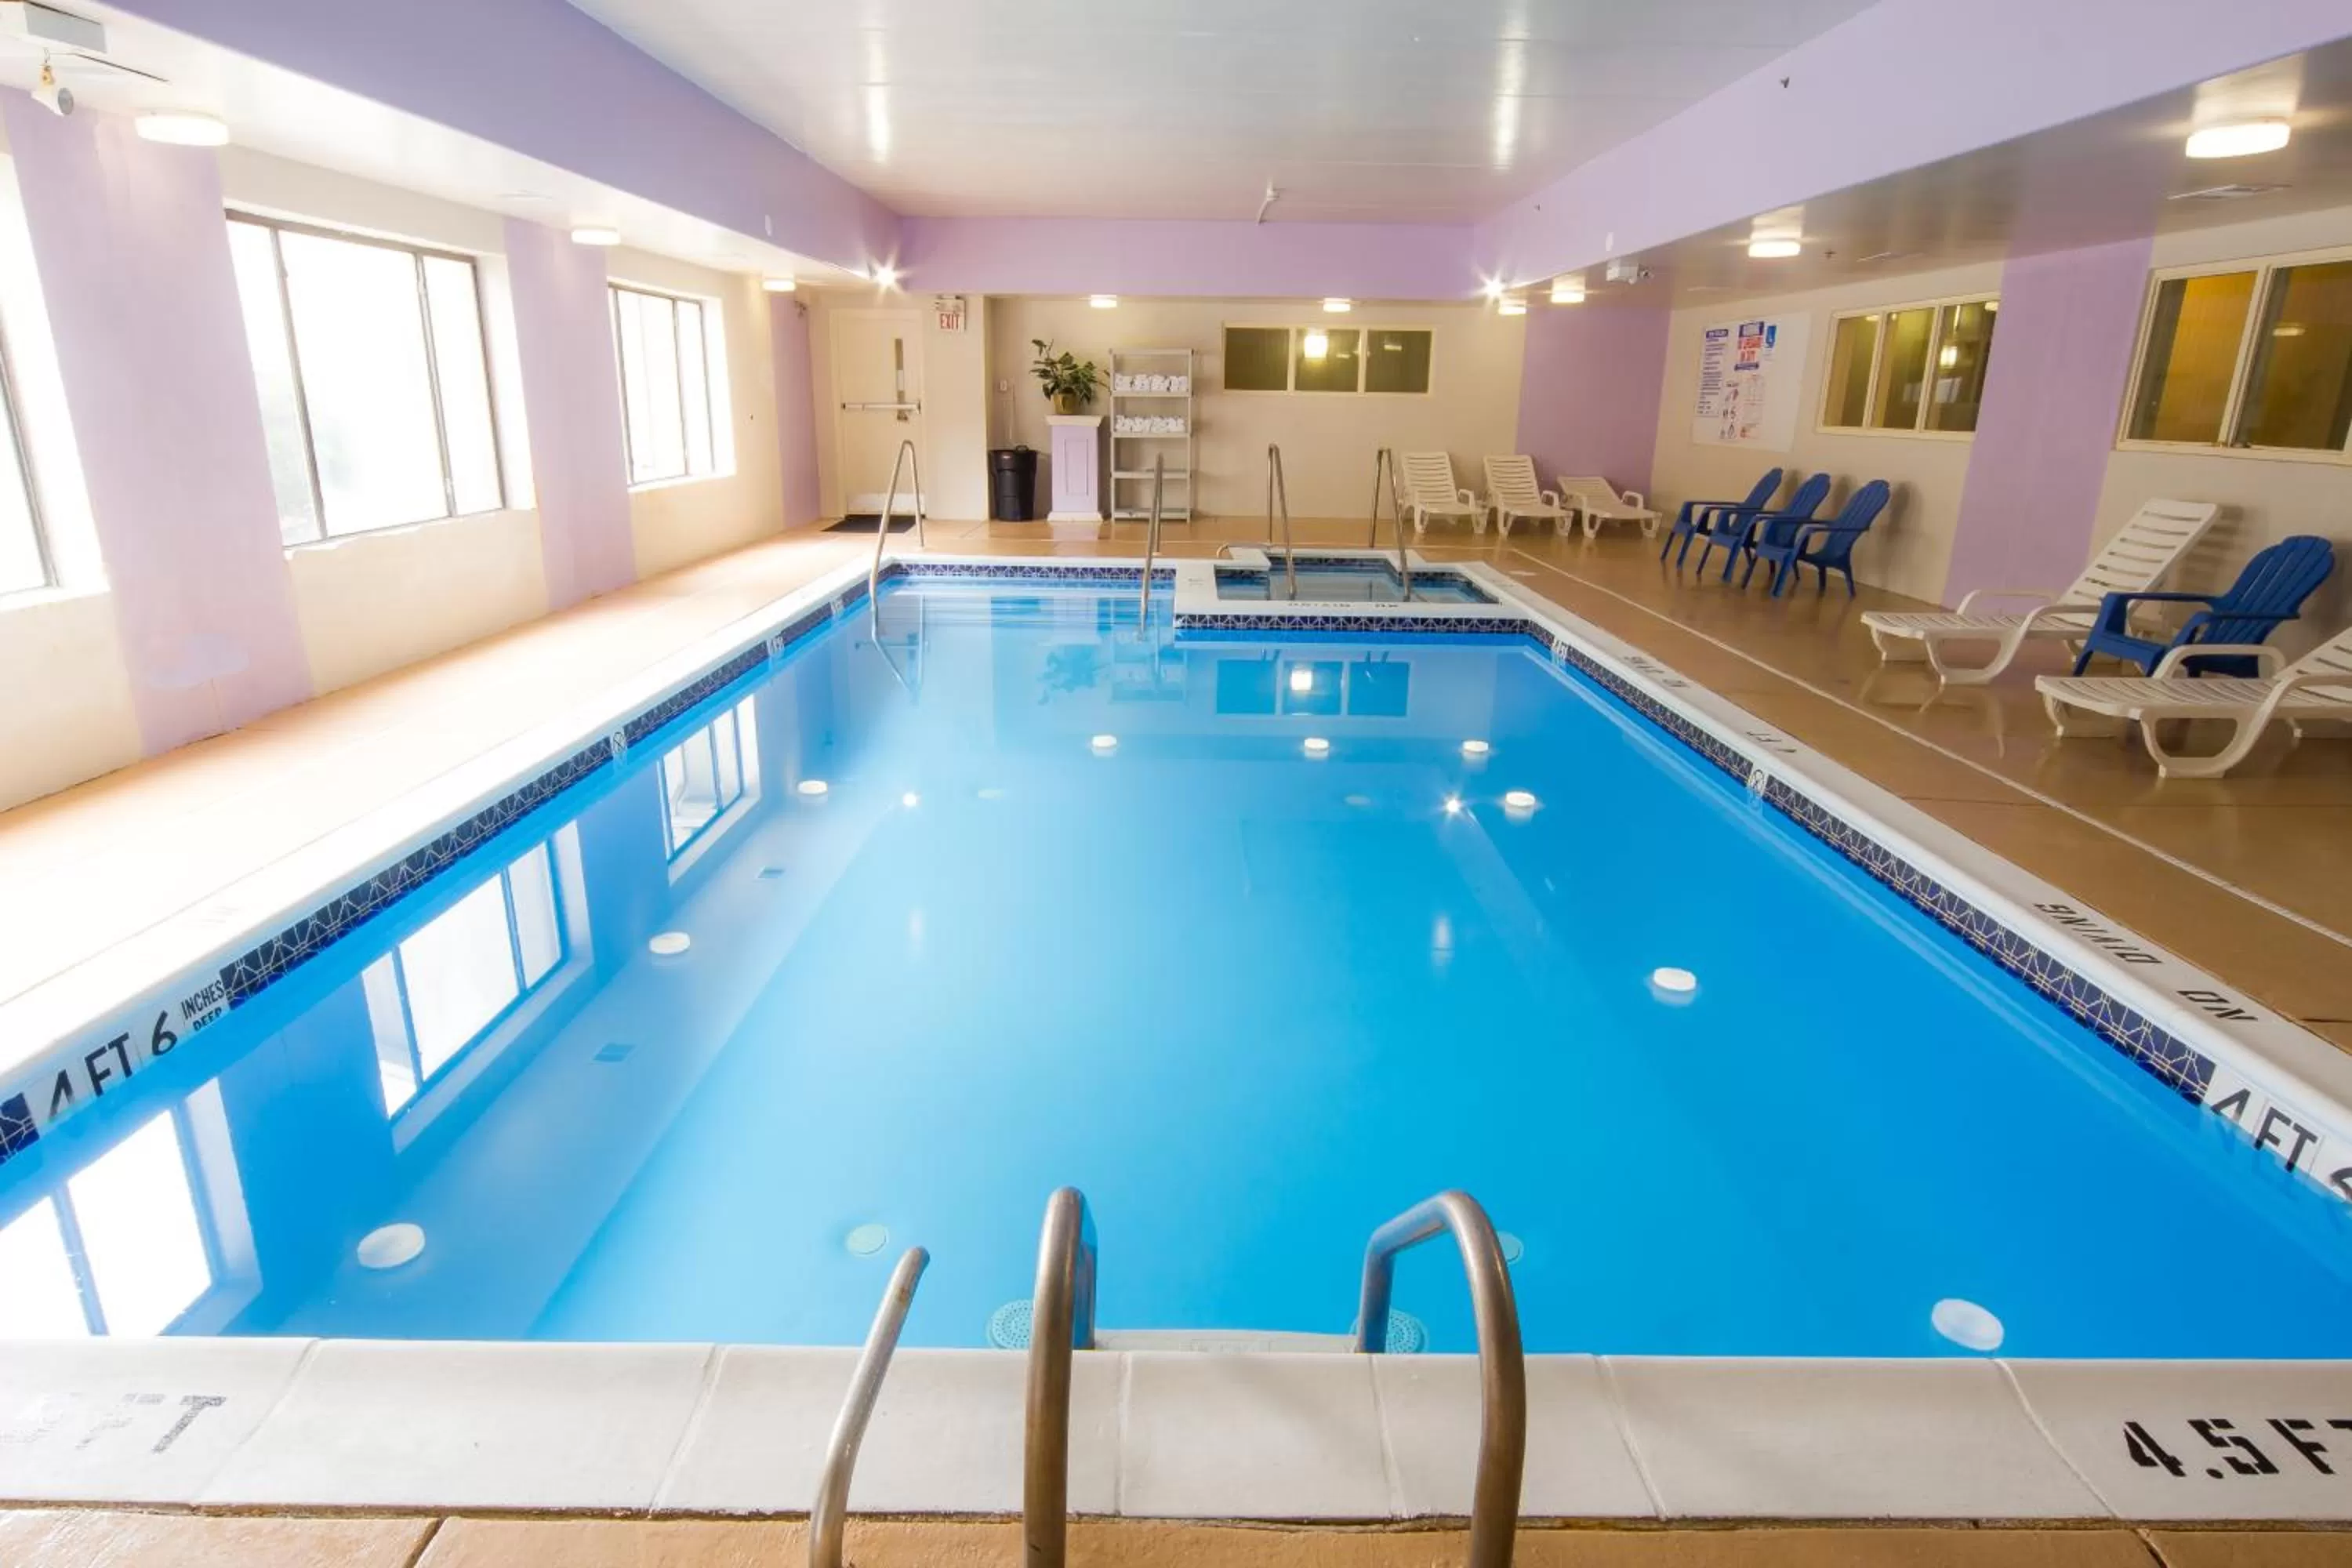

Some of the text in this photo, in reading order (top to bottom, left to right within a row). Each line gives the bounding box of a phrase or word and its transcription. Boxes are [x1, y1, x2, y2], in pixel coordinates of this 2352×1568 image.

[940, 313, 960, 330] EXIT
[2034, 903, 2259, 1021] NO DIVING
[84, 1032, 133, 1098] FT
[151, 1010, 178, 1057] 6
[181, 980, 224, 1020] INCHES
[2254, 1106, 2318, 1173] FT
